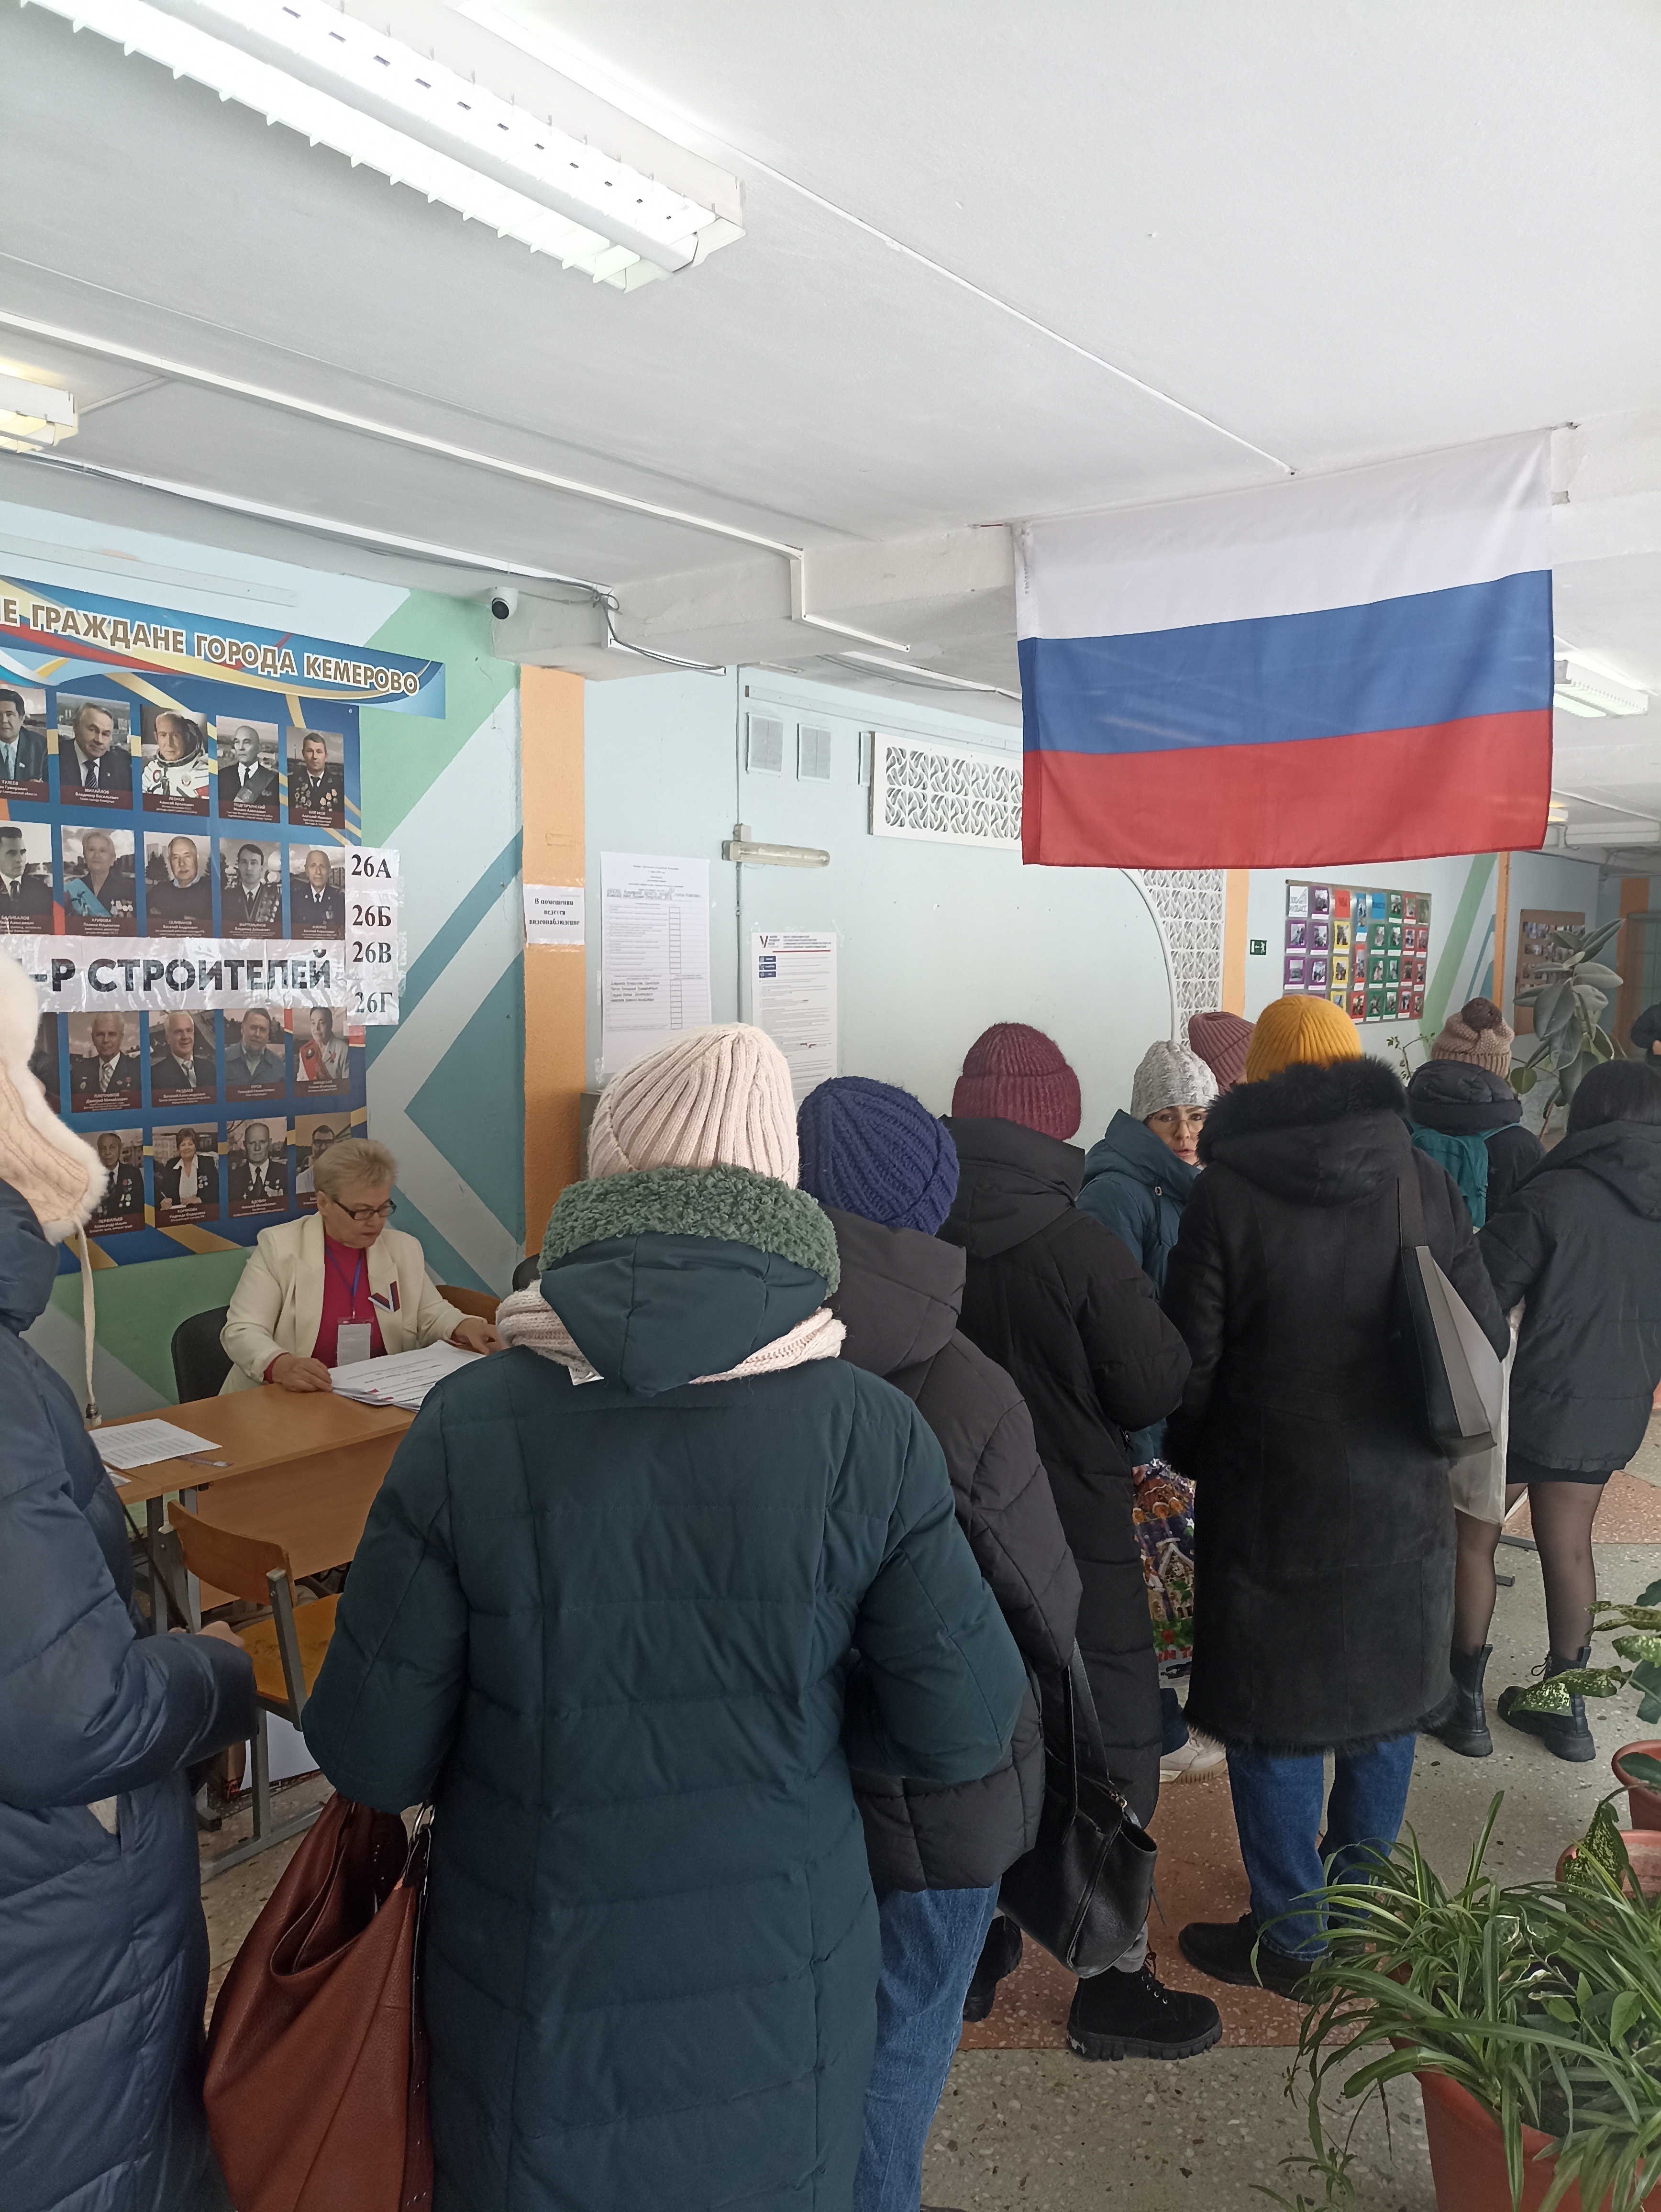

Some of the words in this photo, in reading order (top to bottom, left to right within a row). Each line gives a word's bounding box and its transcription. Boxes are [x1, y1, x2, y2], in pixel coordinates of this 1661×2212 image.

[0, 597, 18, 624] Е
[32, 604, 185, 654] ГРАЖДАНЕ
[197, 635, 296, 675] ГОРОДА
[306, 655, 418, 695] КЕМЕРОВО
[351, 854, 392, 878] 26А
[352, 904, 391, 927] 26Б
[353, 941, 392, 963] 26В
[16, 958, 76, 992] -Р
[88, 949, 331, 992] СТРОИТЕЛЕЙ
[354, 992, 393, 1013] 26Г
